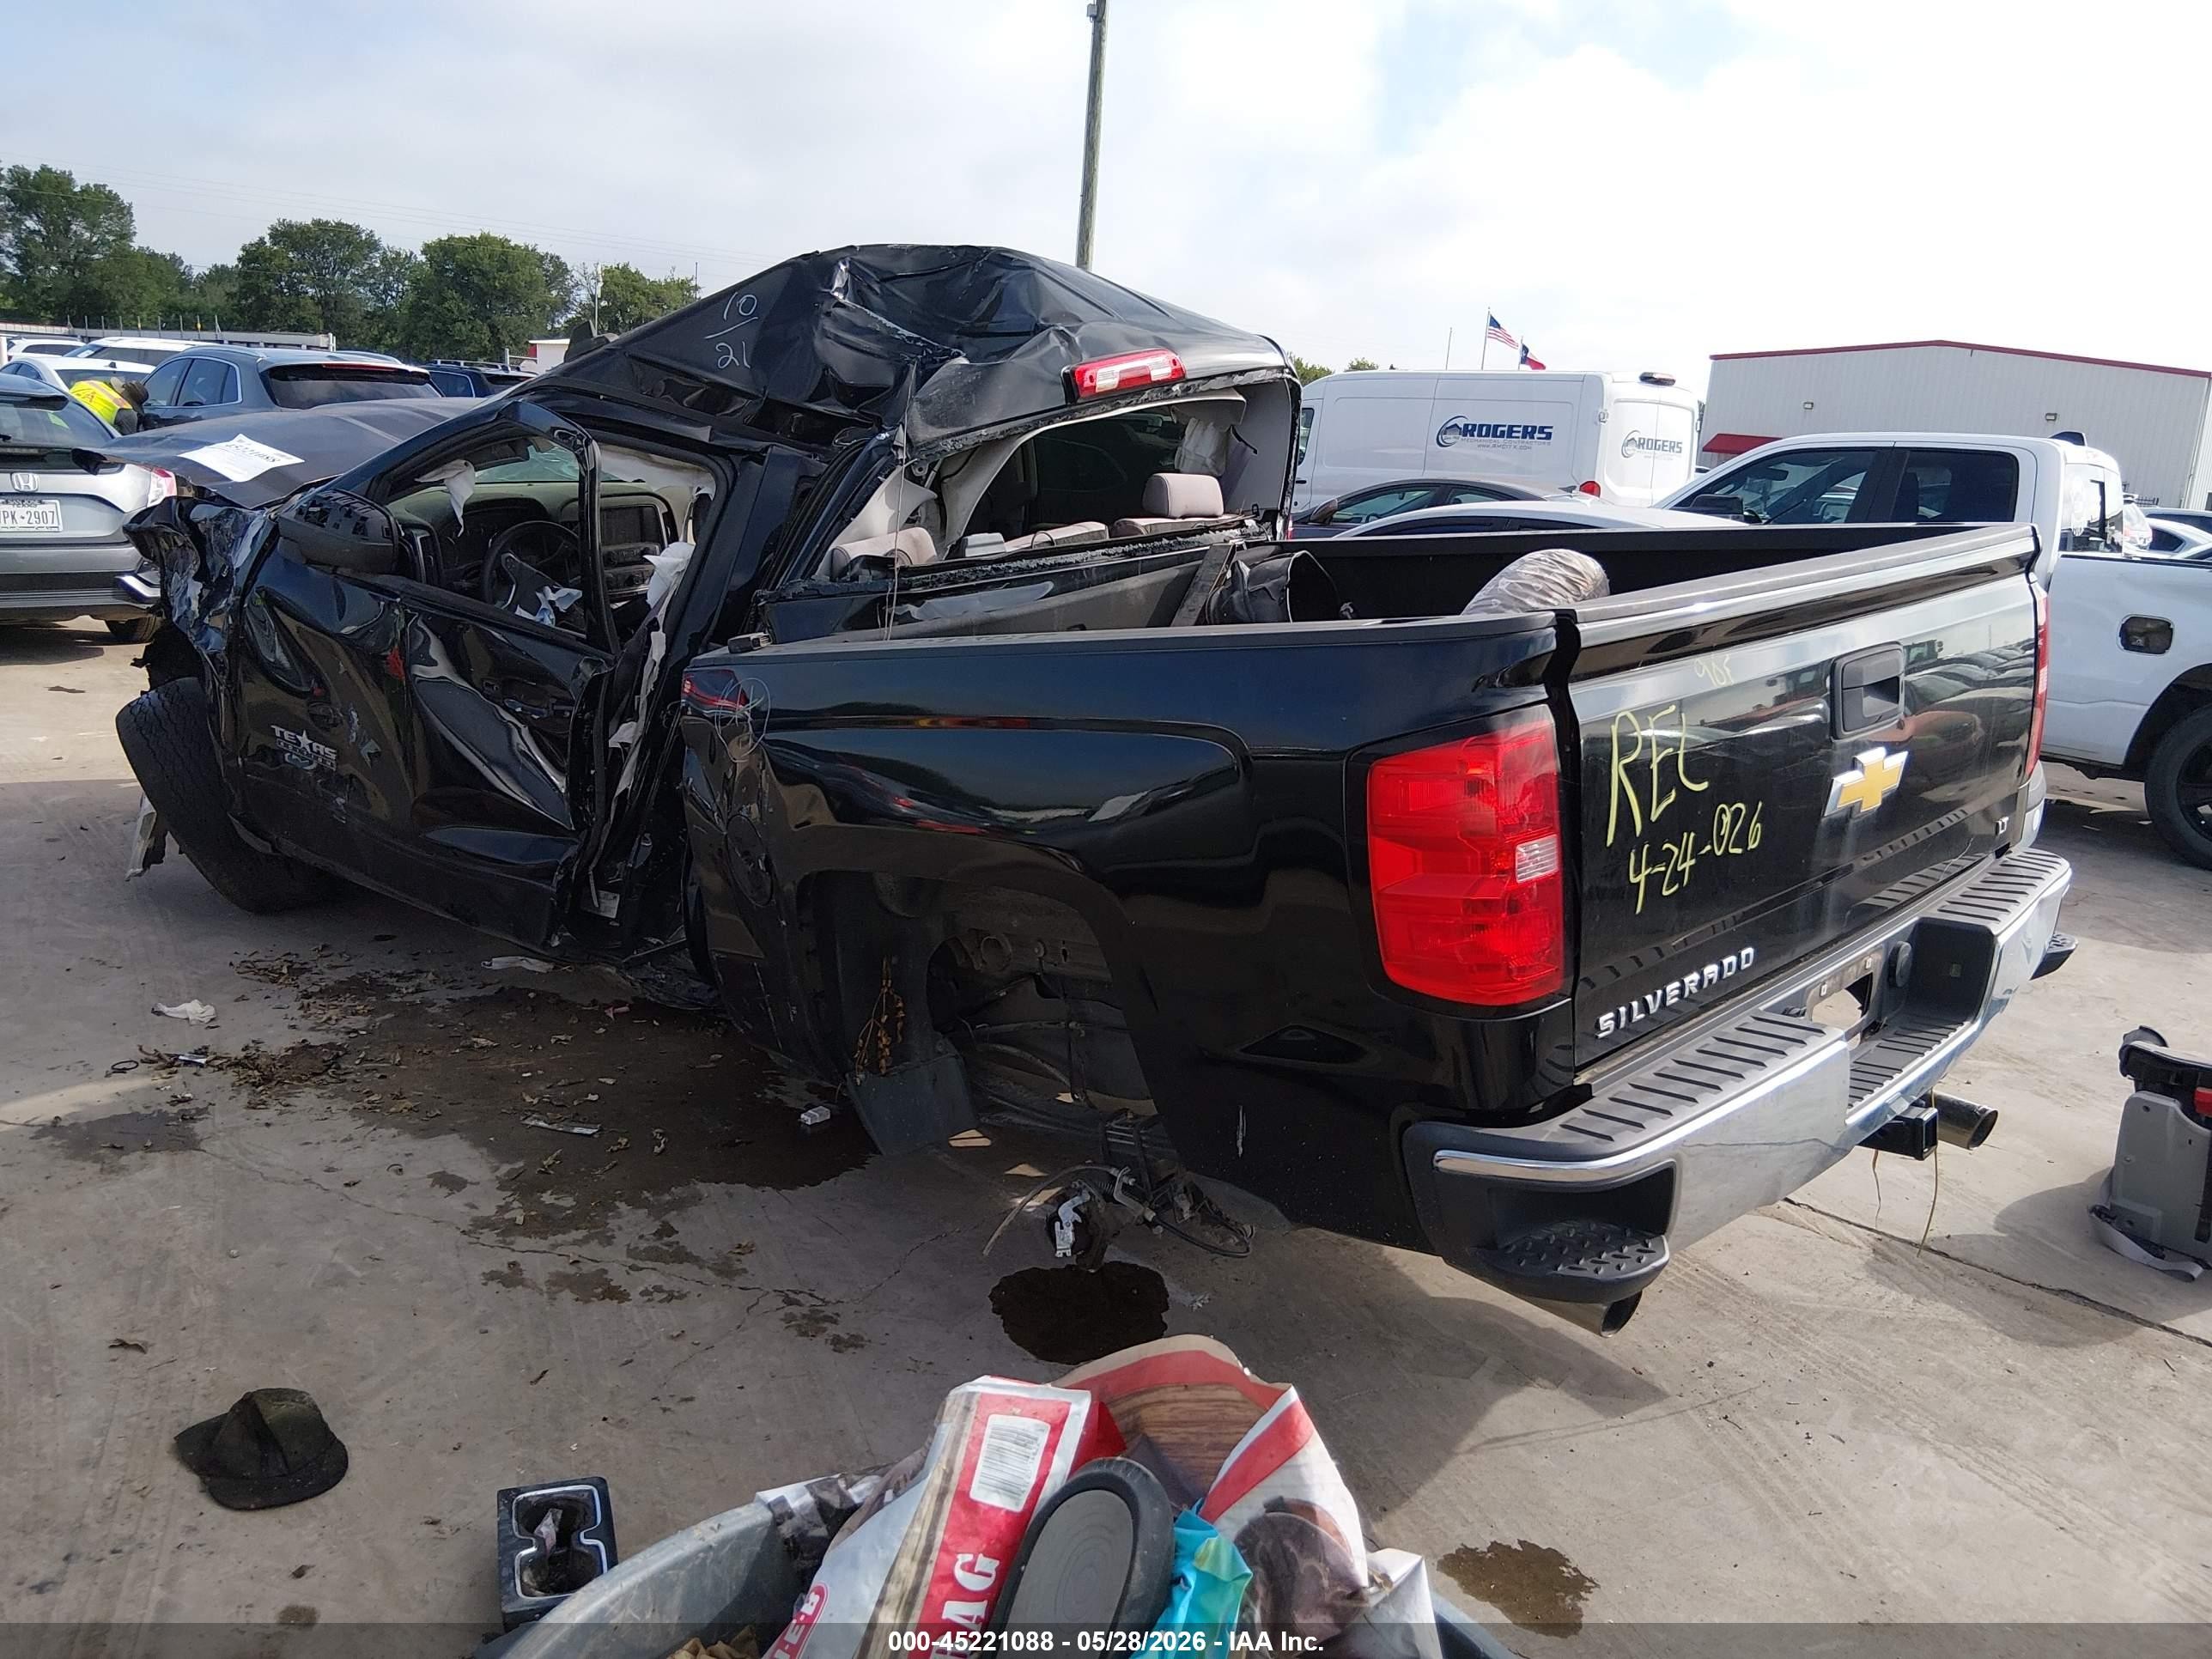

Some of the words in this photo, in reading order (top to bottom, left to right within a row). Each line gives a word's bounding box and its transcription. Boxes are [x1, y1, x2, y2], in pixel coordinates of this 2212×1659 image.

[723, 291, 757, 320] 10
[715, 341, 751, 369] 21
[1462, 422, 1553, 441] ROGERS
[1637, 437, 1682, 453] ROGERS
[1595, 947, 1754, 1039] SILVERADO
